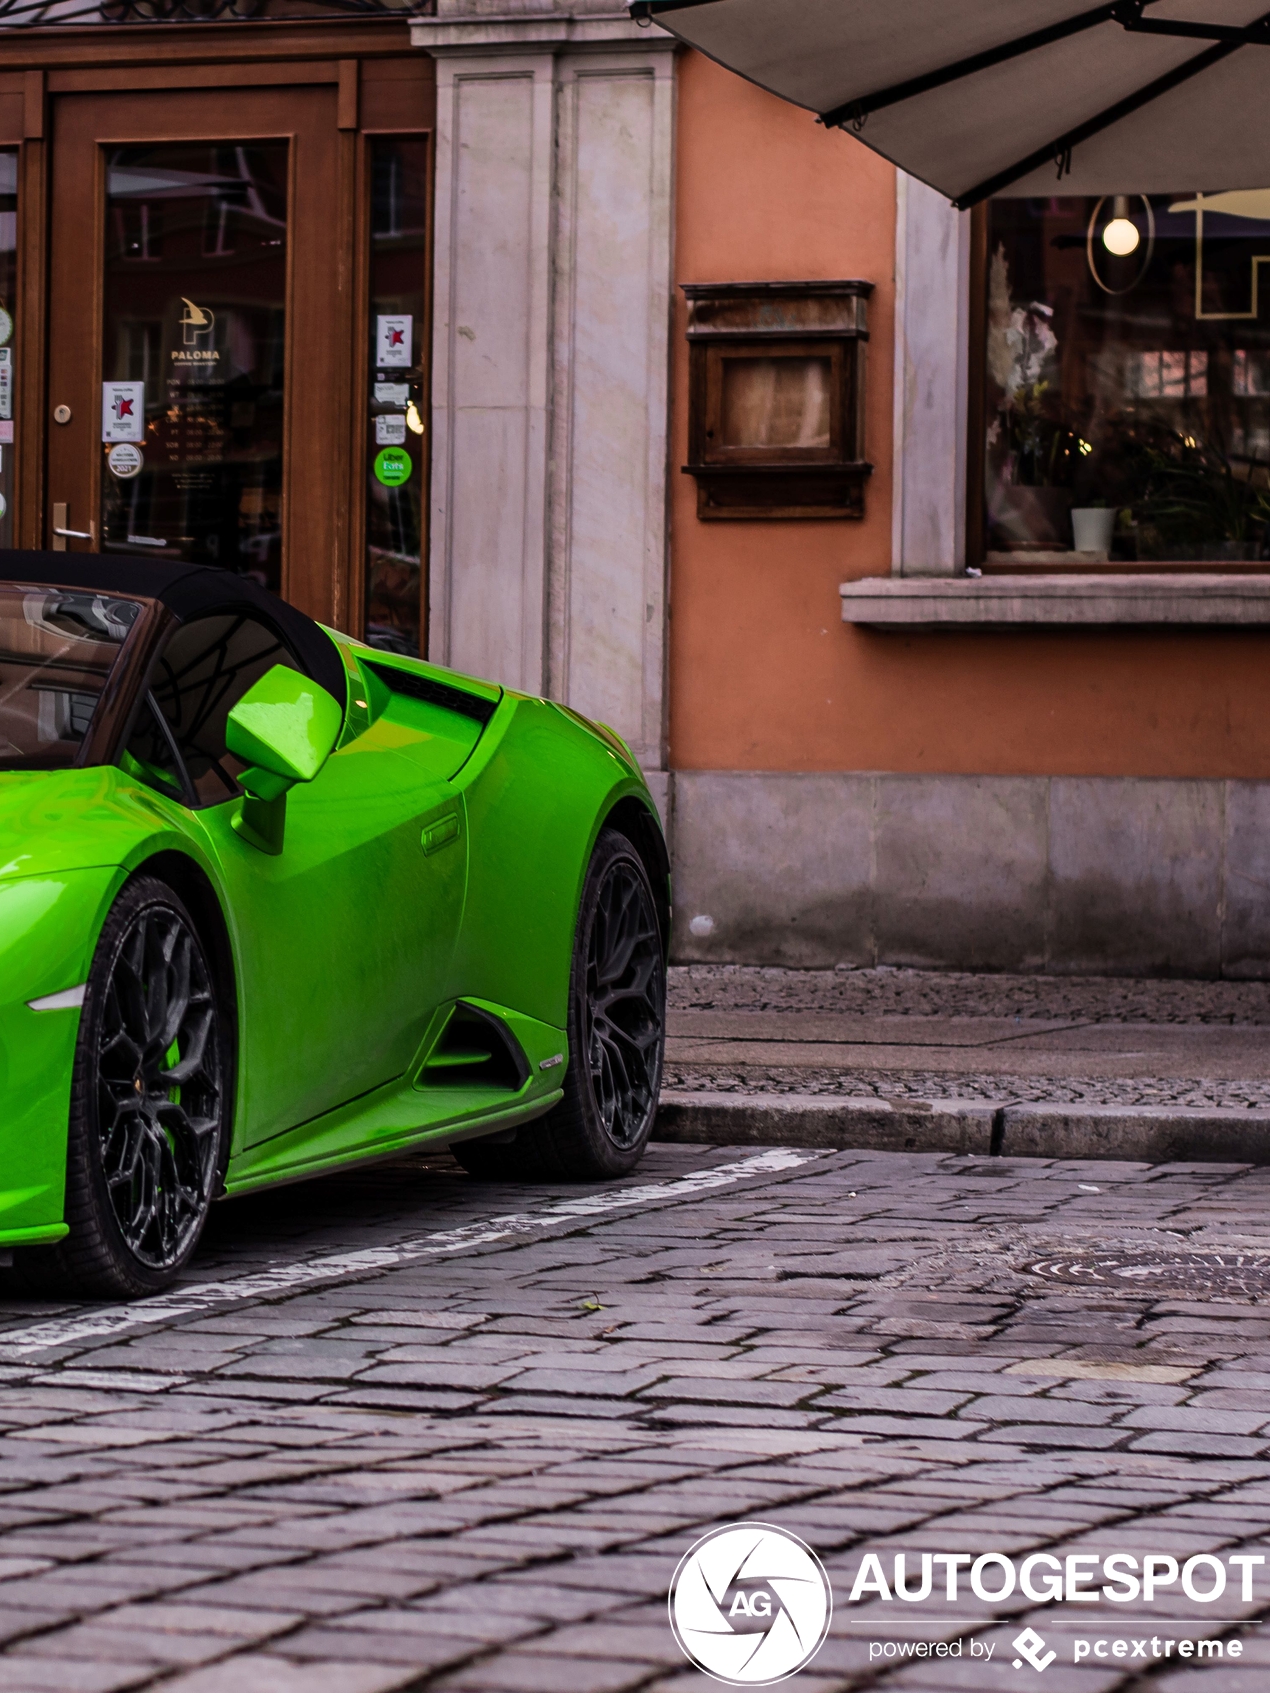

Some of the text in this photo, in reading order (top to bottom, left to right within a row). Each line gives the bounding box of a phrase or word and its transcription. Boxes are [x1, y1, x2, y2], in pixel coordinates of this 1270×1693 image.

[171, 350, 220, 360] PALOMA
[383, 453, 404, 461] Uber
[383, 461, 404, 471] Eats
